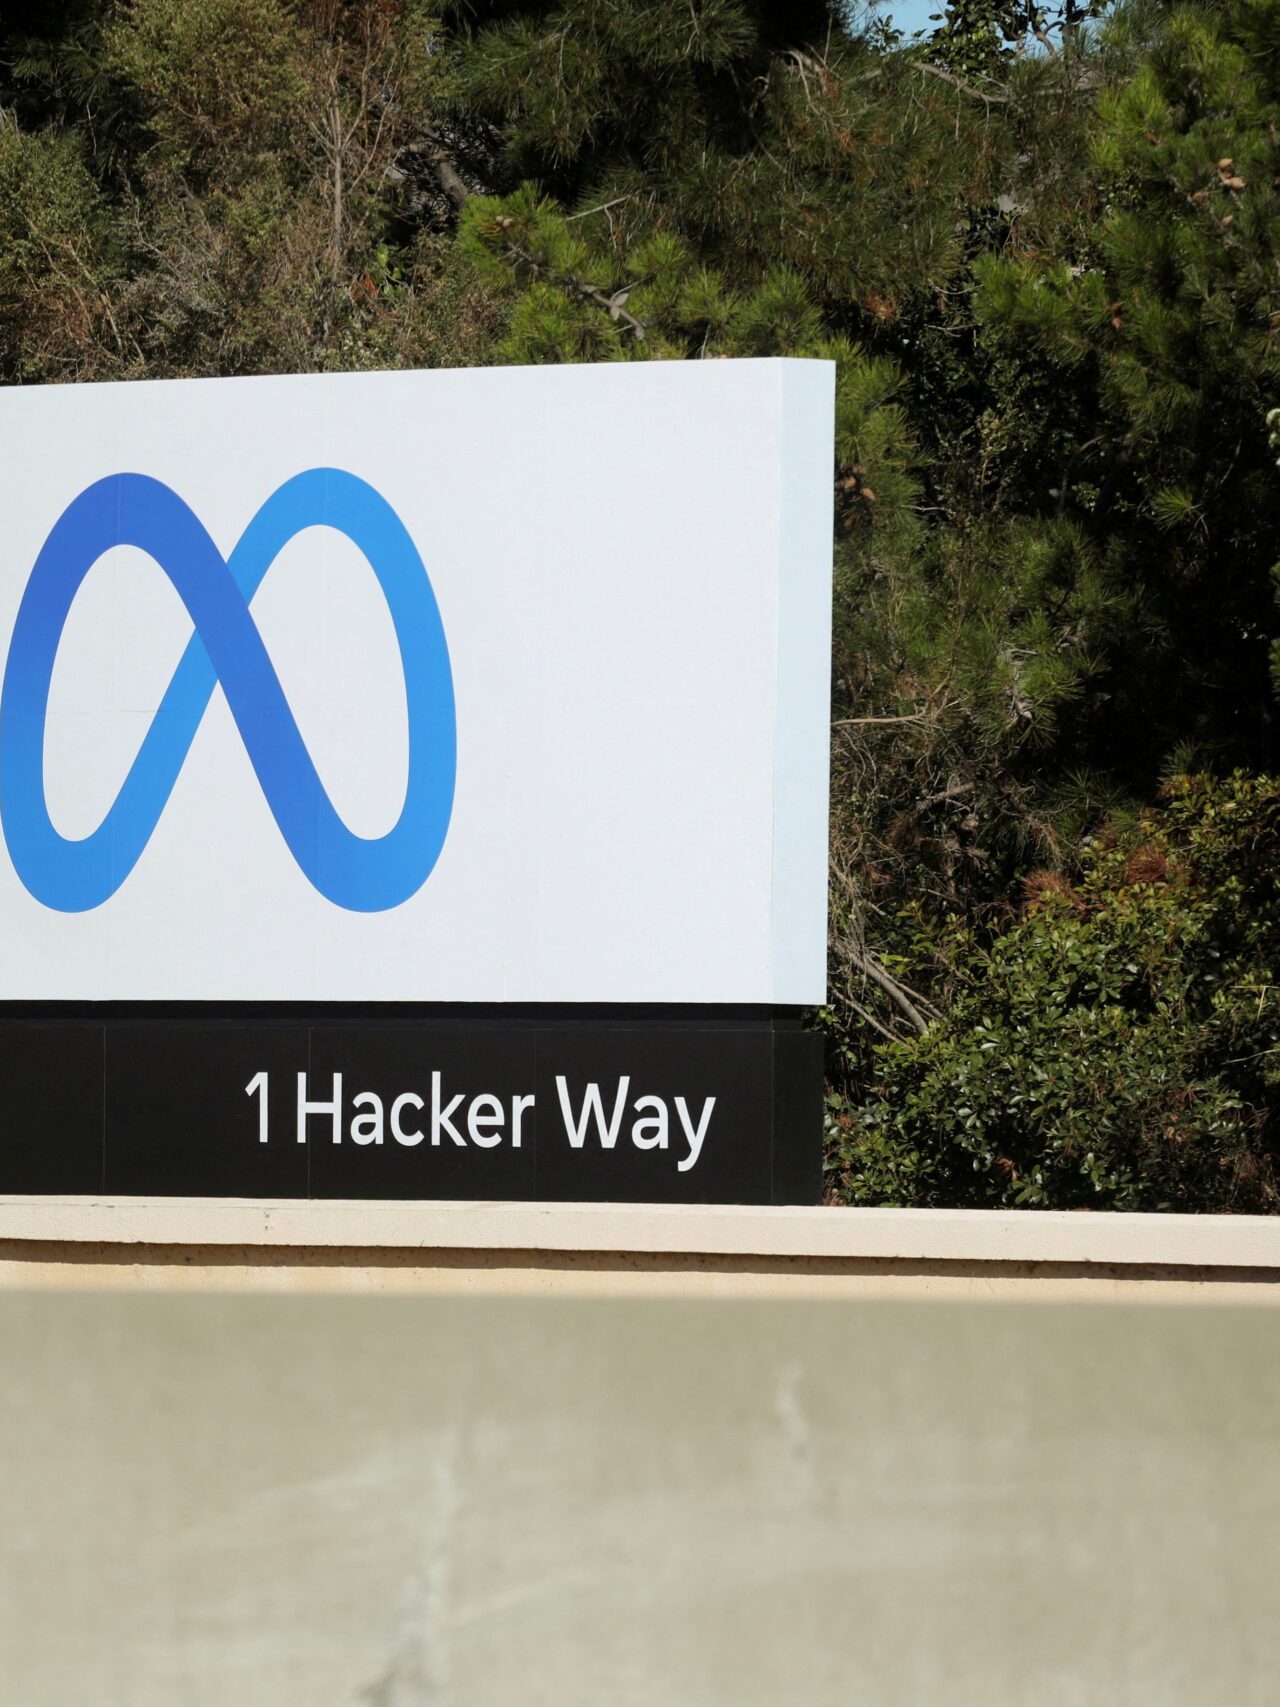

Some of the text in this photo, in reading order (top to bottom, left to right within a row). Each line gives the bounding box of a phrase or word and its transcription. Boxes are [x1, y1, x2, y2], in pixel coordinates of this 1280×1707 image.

[245, 1071, 716, 1171] 1 Hacker Way
